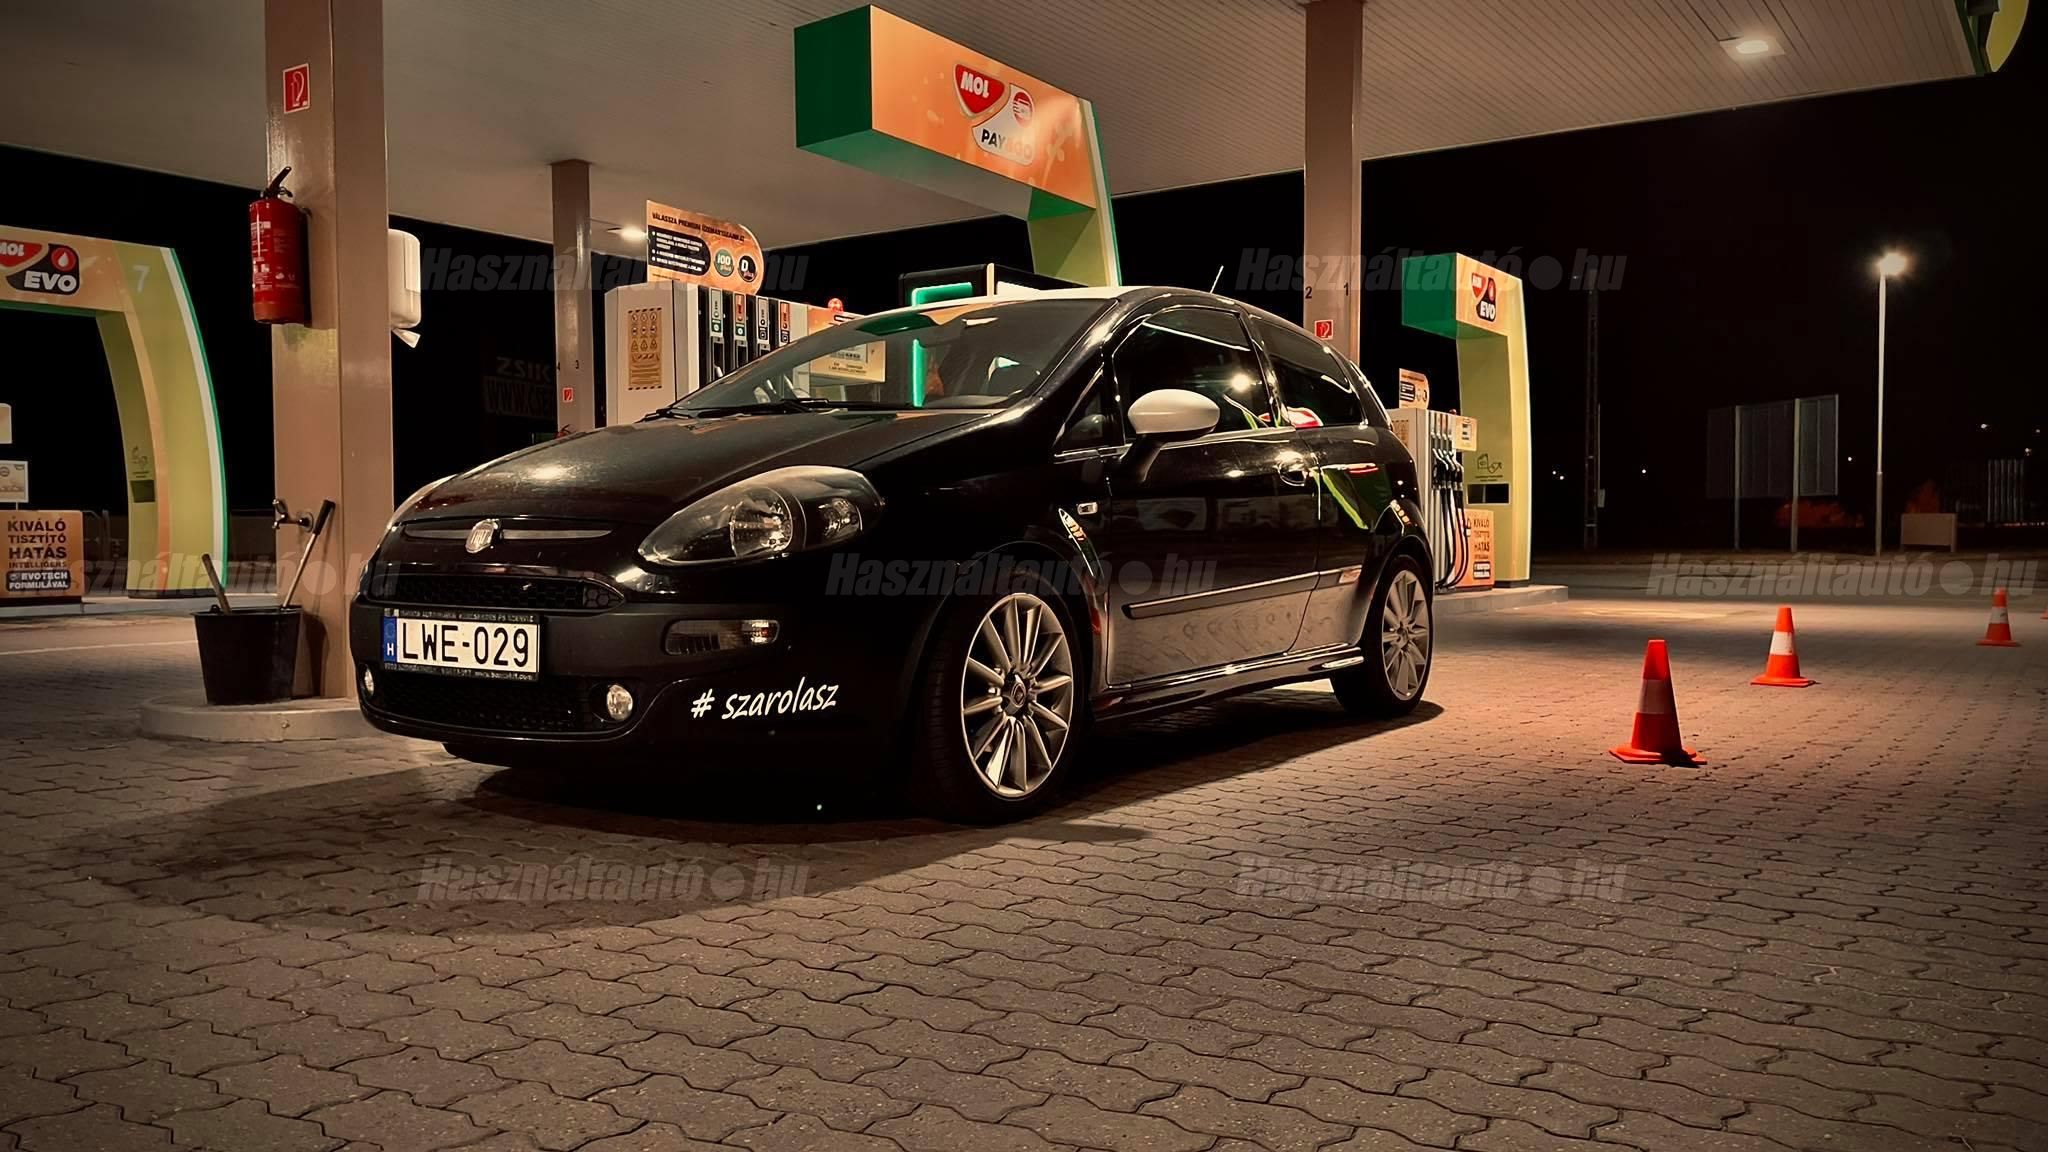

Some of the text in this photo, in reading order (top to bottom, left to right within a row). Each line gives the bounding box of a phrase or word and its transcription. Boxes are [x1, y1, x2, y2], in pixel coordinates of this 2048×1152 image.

[960, 71, 990, 99] MOL
[717, 253, 731, 266] 100
[740, 258, 749, 272] D
[24, 270, 77, 292] EVO
[132, 264, 150, 293] 7
[1304, 286, 1313, 300] 2
[1480, 300, 1496, 320] EVO
[8, 518, 67, 532] KIVÁLÓ
[8, 532, 67, 544] TISZTÍTÓ
[8, 544, 67, 559] HATÁS
[21, 571, 68, 580] EVOTECH
[9, 580, 69, 590] FORMULÁVAL
[386, 642, 394, 657] H
[403, 622, 529, 667] LWE-029
[721, 676, 840, 720] szarolasz
